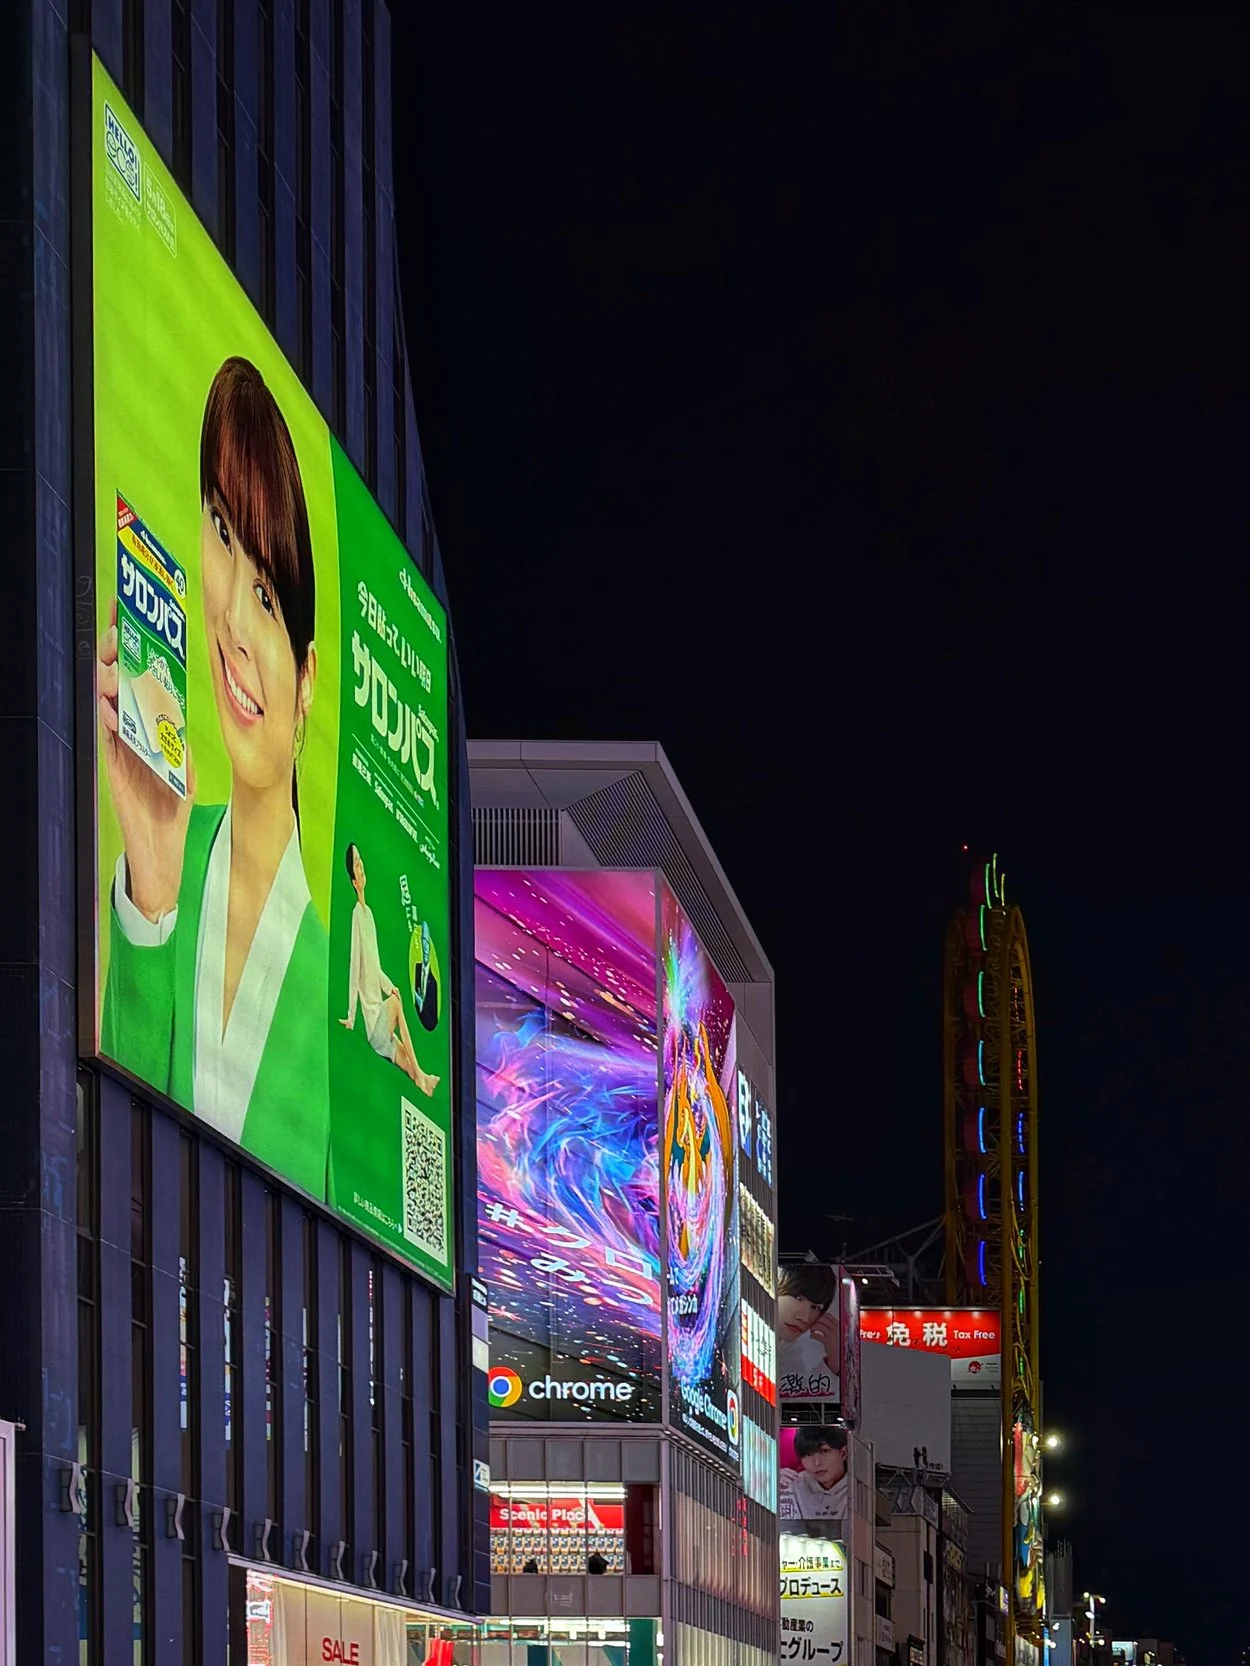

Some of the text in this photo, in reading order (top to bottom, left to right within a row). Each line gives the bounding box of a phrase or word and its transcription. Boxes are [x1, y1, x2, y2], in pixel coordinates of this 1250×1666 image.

[121, 553, 186, 661] サロンパス
[351, 629, 438, 812] サロンパス
[886, 1321, 948, 1347] 免税
[953, 1329, 996, 1340] Tax Free
[528, 1375, 632, 1401] chrome
[780, 1619, 814, 1634] 動産業の
[322, 1637, 360, 1666] SALE
